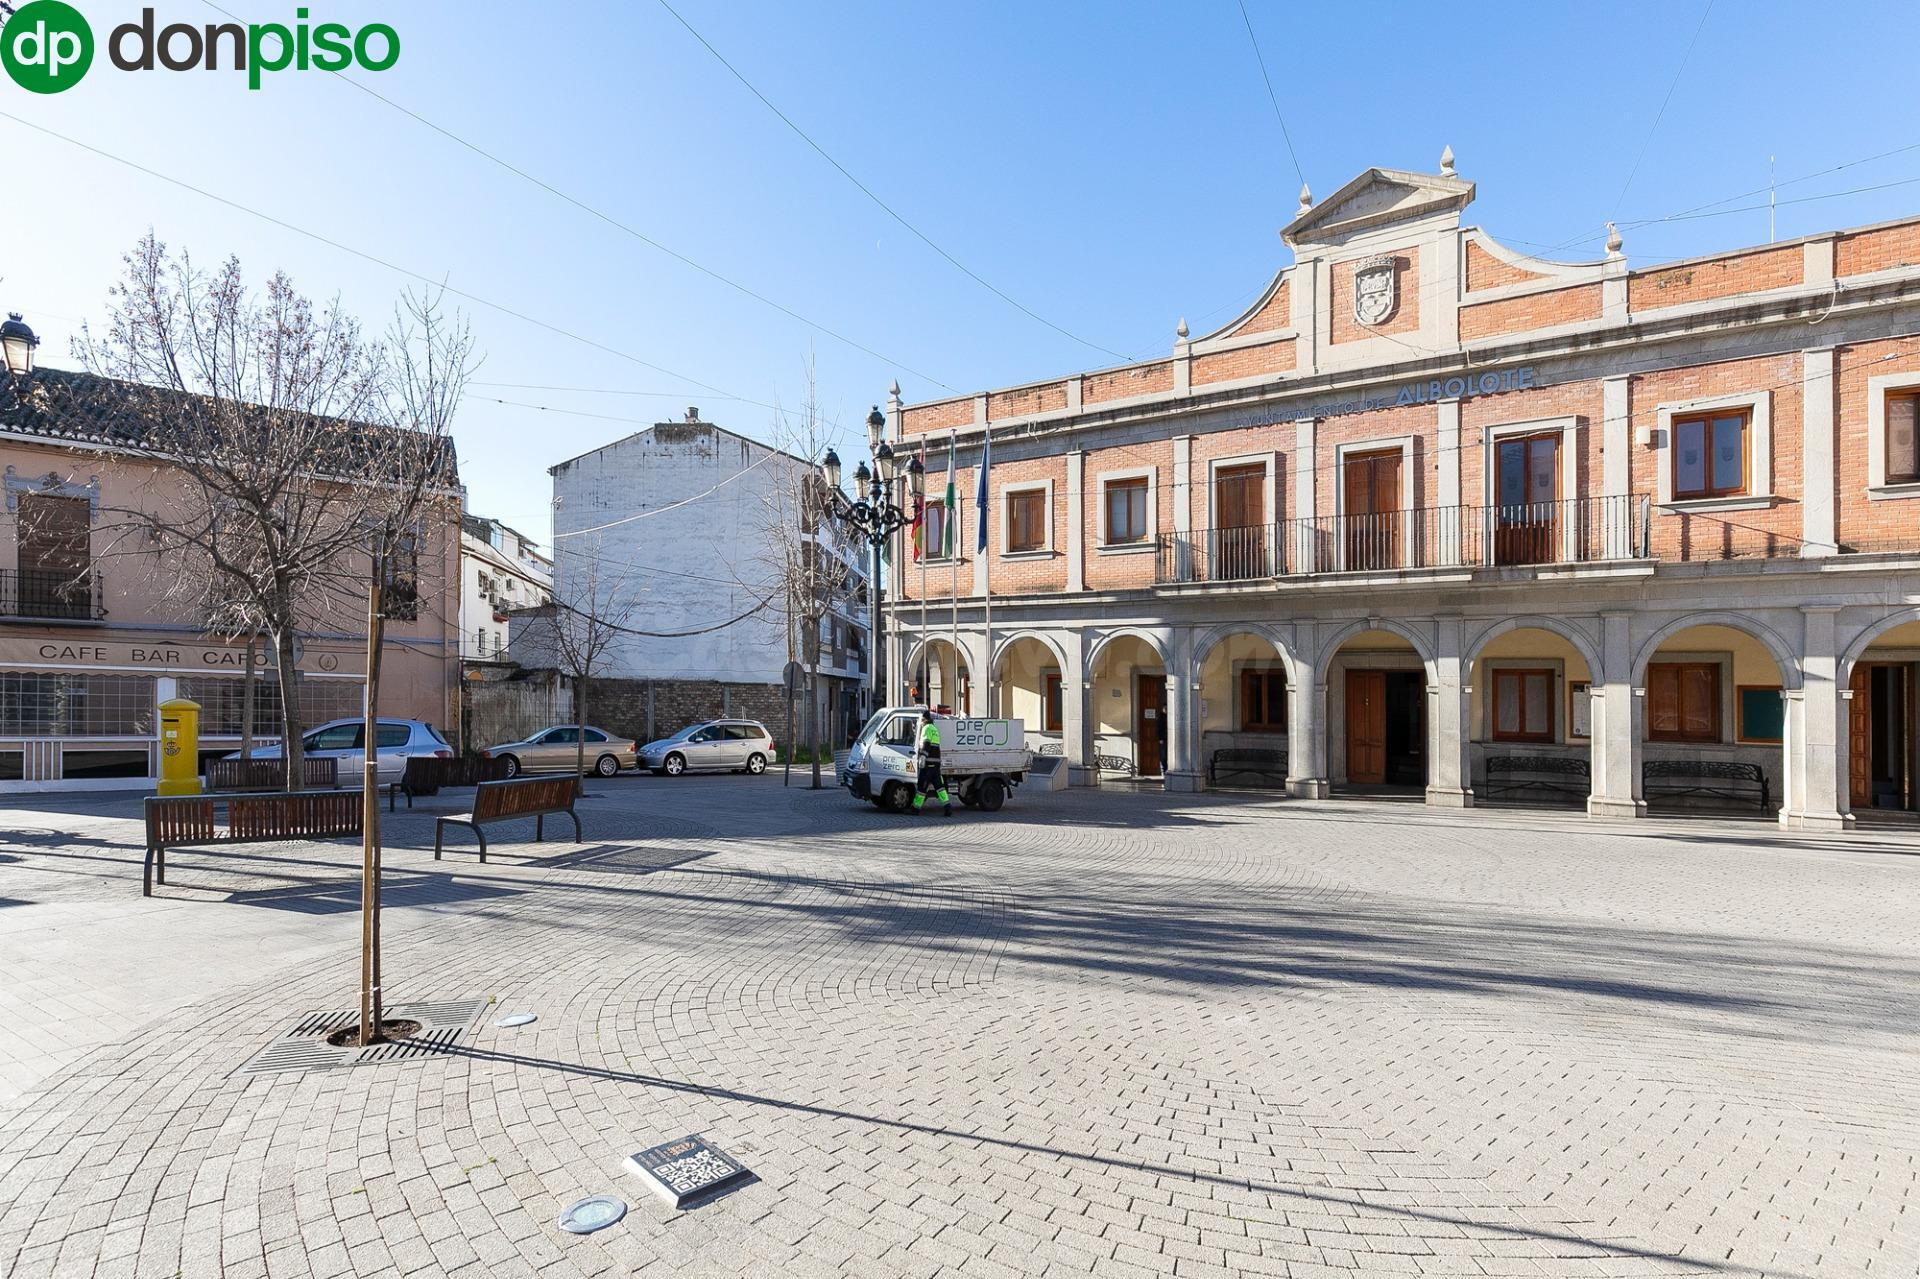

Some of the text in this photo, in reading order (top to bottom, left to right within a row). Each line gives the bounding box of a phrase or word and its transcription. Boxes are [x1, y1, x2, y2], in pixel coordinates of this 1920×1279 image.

[1396, 366, 1534, 406] ALBOLOTE
[39, 645, 107, 661] CAFE
[132, 649, 180, 663] BAR
[956, 720, 984, 735] pre
[956, 734, 994, 746] zero
[882, 763, 901, 771] zero
